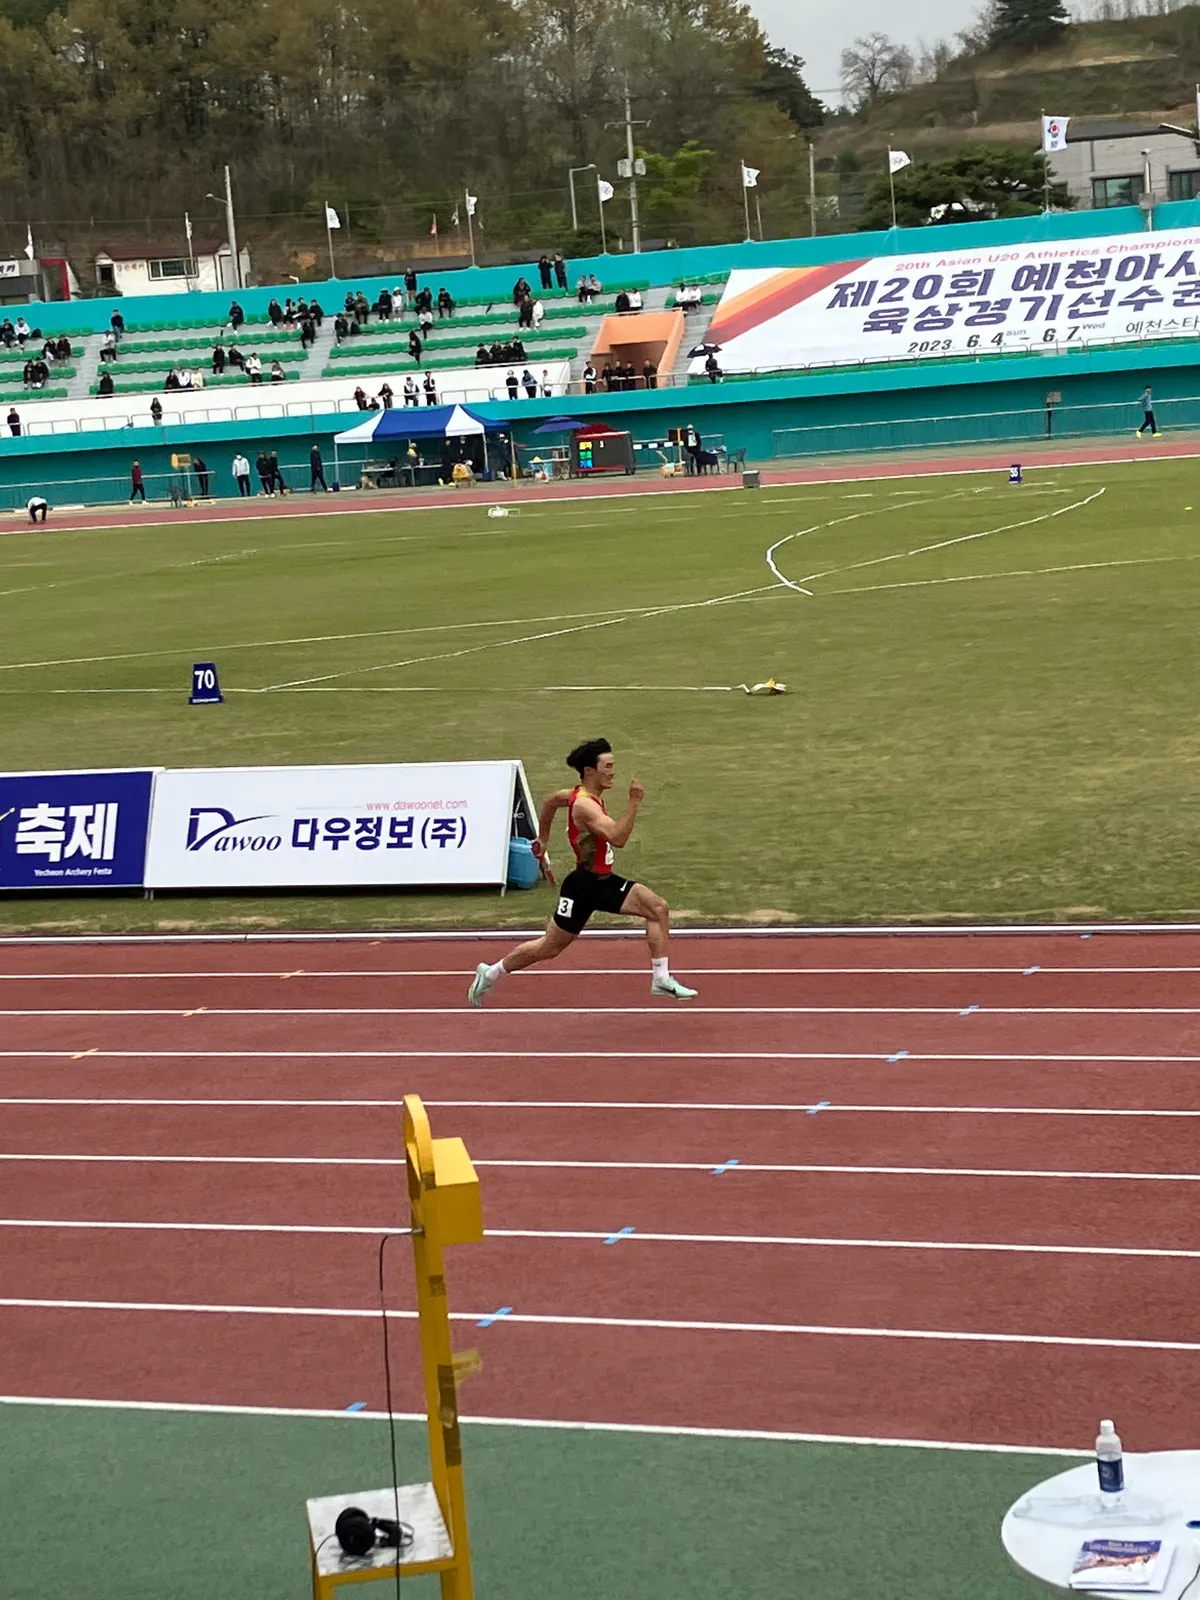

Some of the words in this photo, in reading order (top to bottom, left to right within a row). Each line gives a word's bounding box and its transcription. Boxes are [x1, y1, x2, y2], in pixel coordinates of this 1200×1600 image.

[895, 262, 930, 272] 20th
[936, 257, 981, 268] Asian
[988, 253, 1020, 264] U20
[1025, 249, 1100, 260] Athletics
[825, 268, 996, 310] 제20회
[194, 669, 215, 690] 70
[15, 802, 118, 862] 축제
[291, 816, 467, 851] 다우정보(주)
[560, 900, 569, 914] 3
